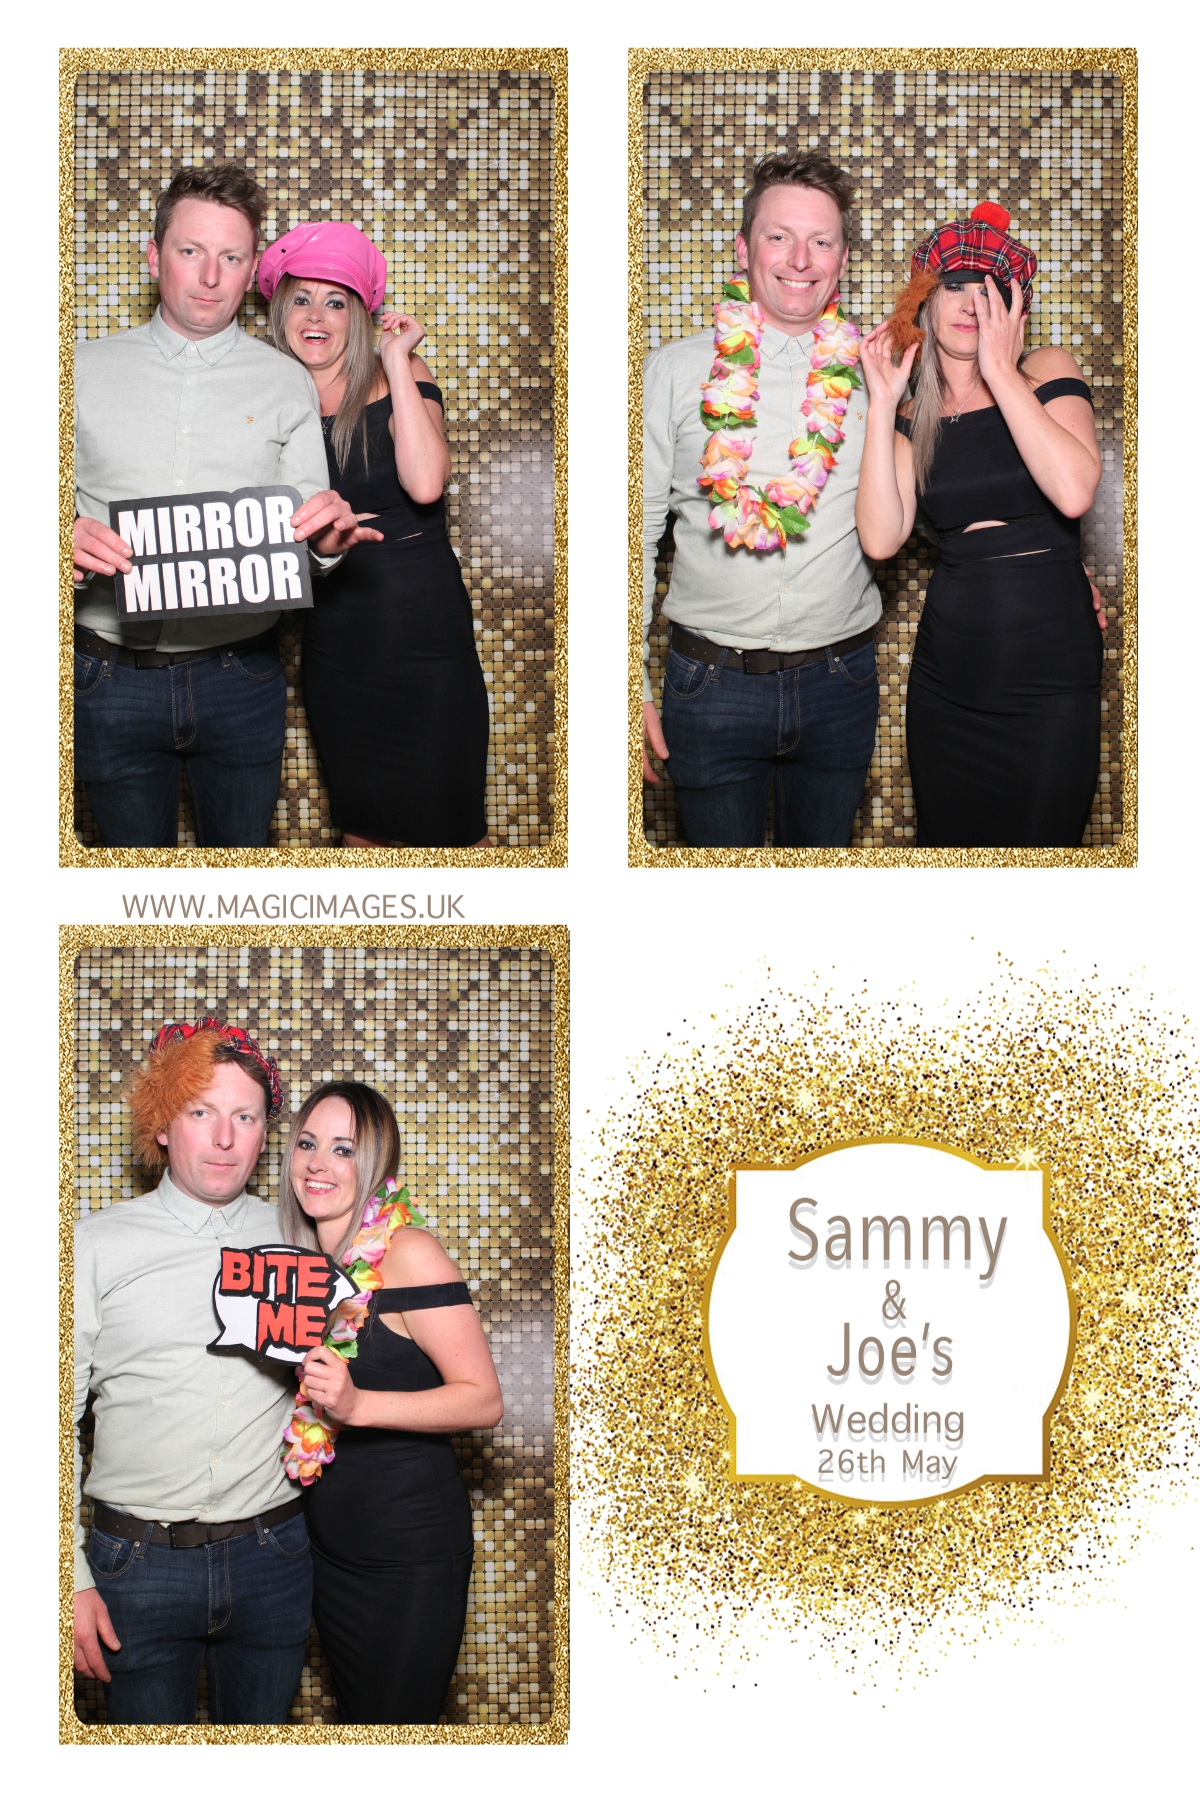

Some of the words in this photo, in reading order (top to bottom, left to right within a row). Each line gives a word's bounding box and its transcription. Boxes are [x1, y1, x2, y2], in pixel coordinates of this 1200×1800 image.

[118, 495, 296, 557] MIRROR
[123, 551, 303, 613] MIRROR
[221, 1250, 332, 1299] BITE
[257, 1301, 328, 1352] ME
